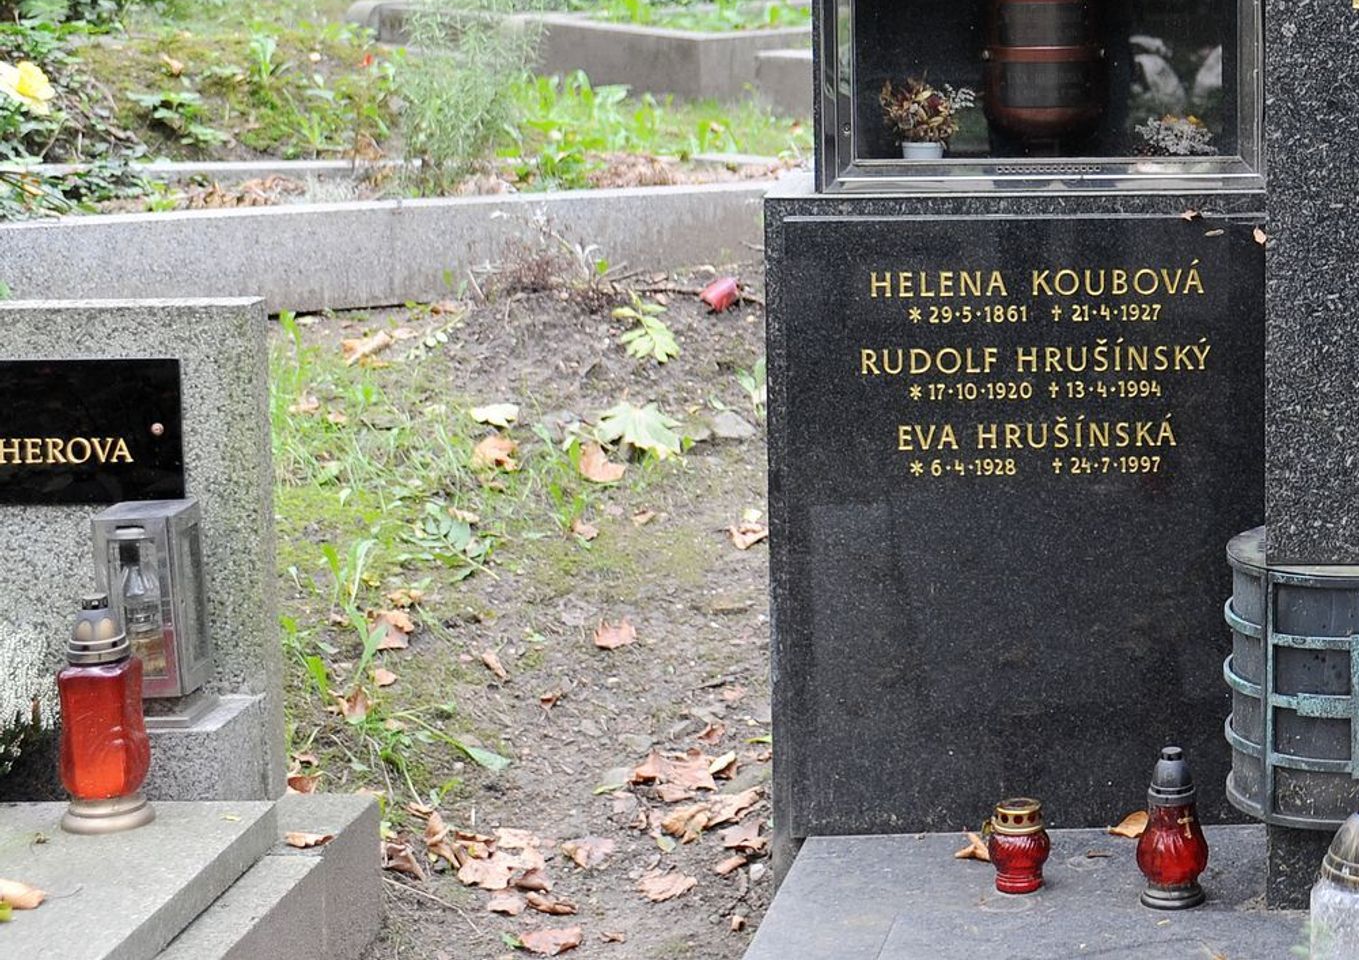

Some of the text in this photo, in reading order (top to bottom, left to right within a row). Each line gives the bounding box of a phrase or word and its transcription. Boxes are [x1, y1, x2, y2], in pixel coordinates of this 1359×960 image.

[869, 259, 1206, 298] HELENA KOUBOVÁ
[861, 337, 1212, 376] RUDOLF HRUŠÍNSKÝ
[0, 437, 134, 464] HEROVA
[898, 413, 1178, 451] EVA HRUŠÍNSKÁ
